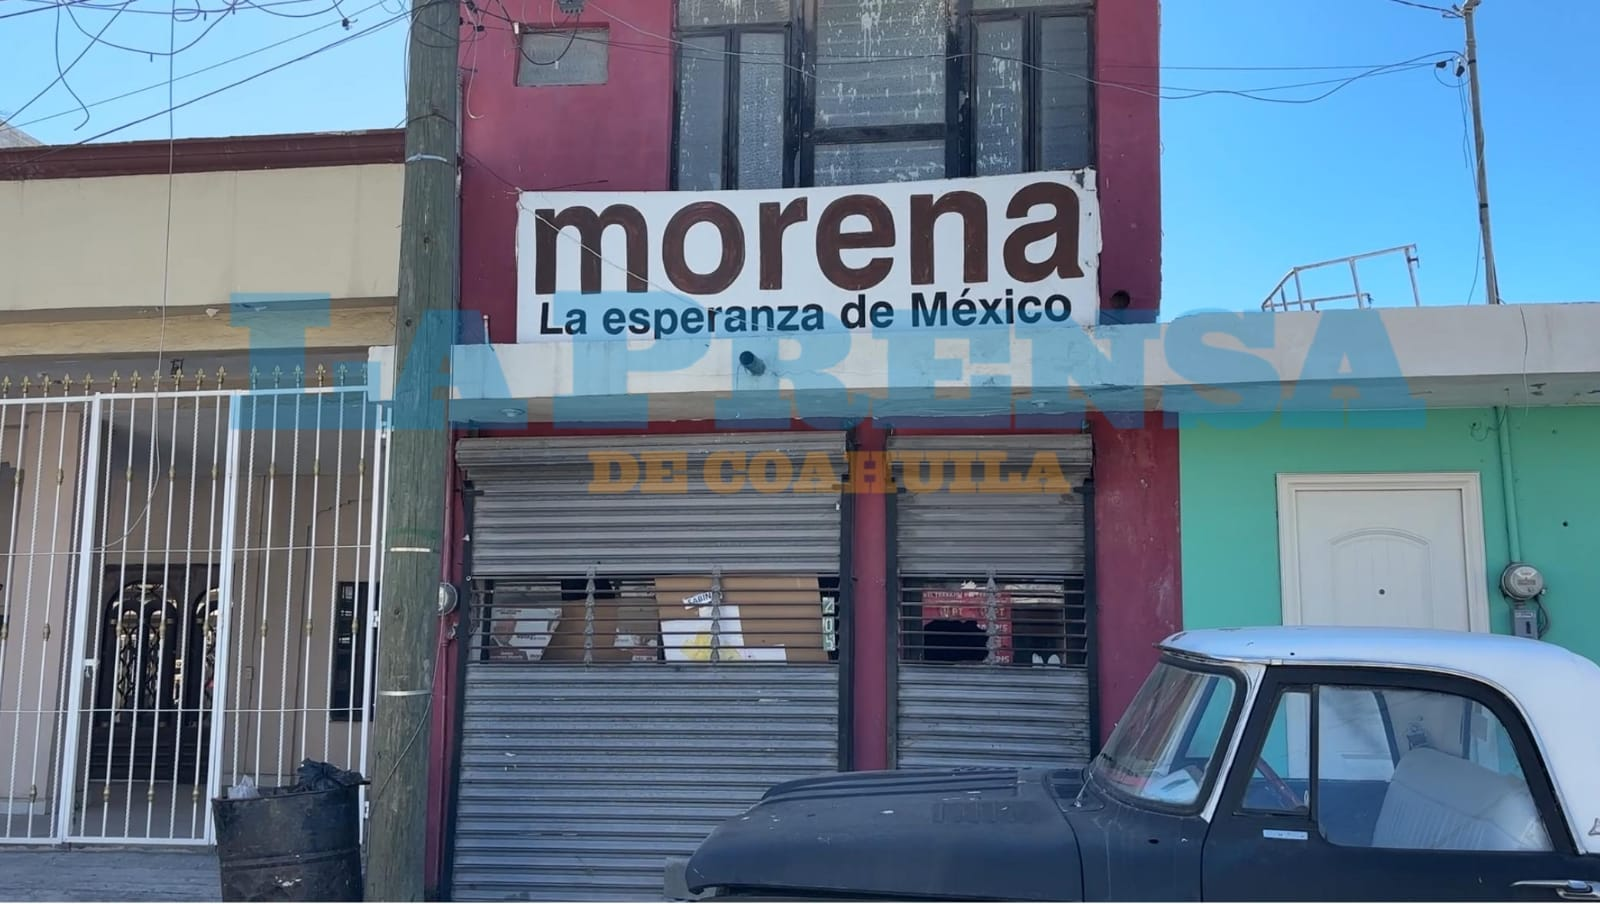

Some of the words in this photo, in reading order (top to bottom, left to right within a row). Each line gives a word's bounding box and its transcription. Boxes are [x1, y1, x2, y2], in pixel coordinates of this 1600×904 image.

[535, 182, 1085, 295] morena
[540, 302, 588, 335] La
[602, 304, 824, 340] esperanza
[840, 294, 894, 328] de
[911, 288, 1072, 327] México
